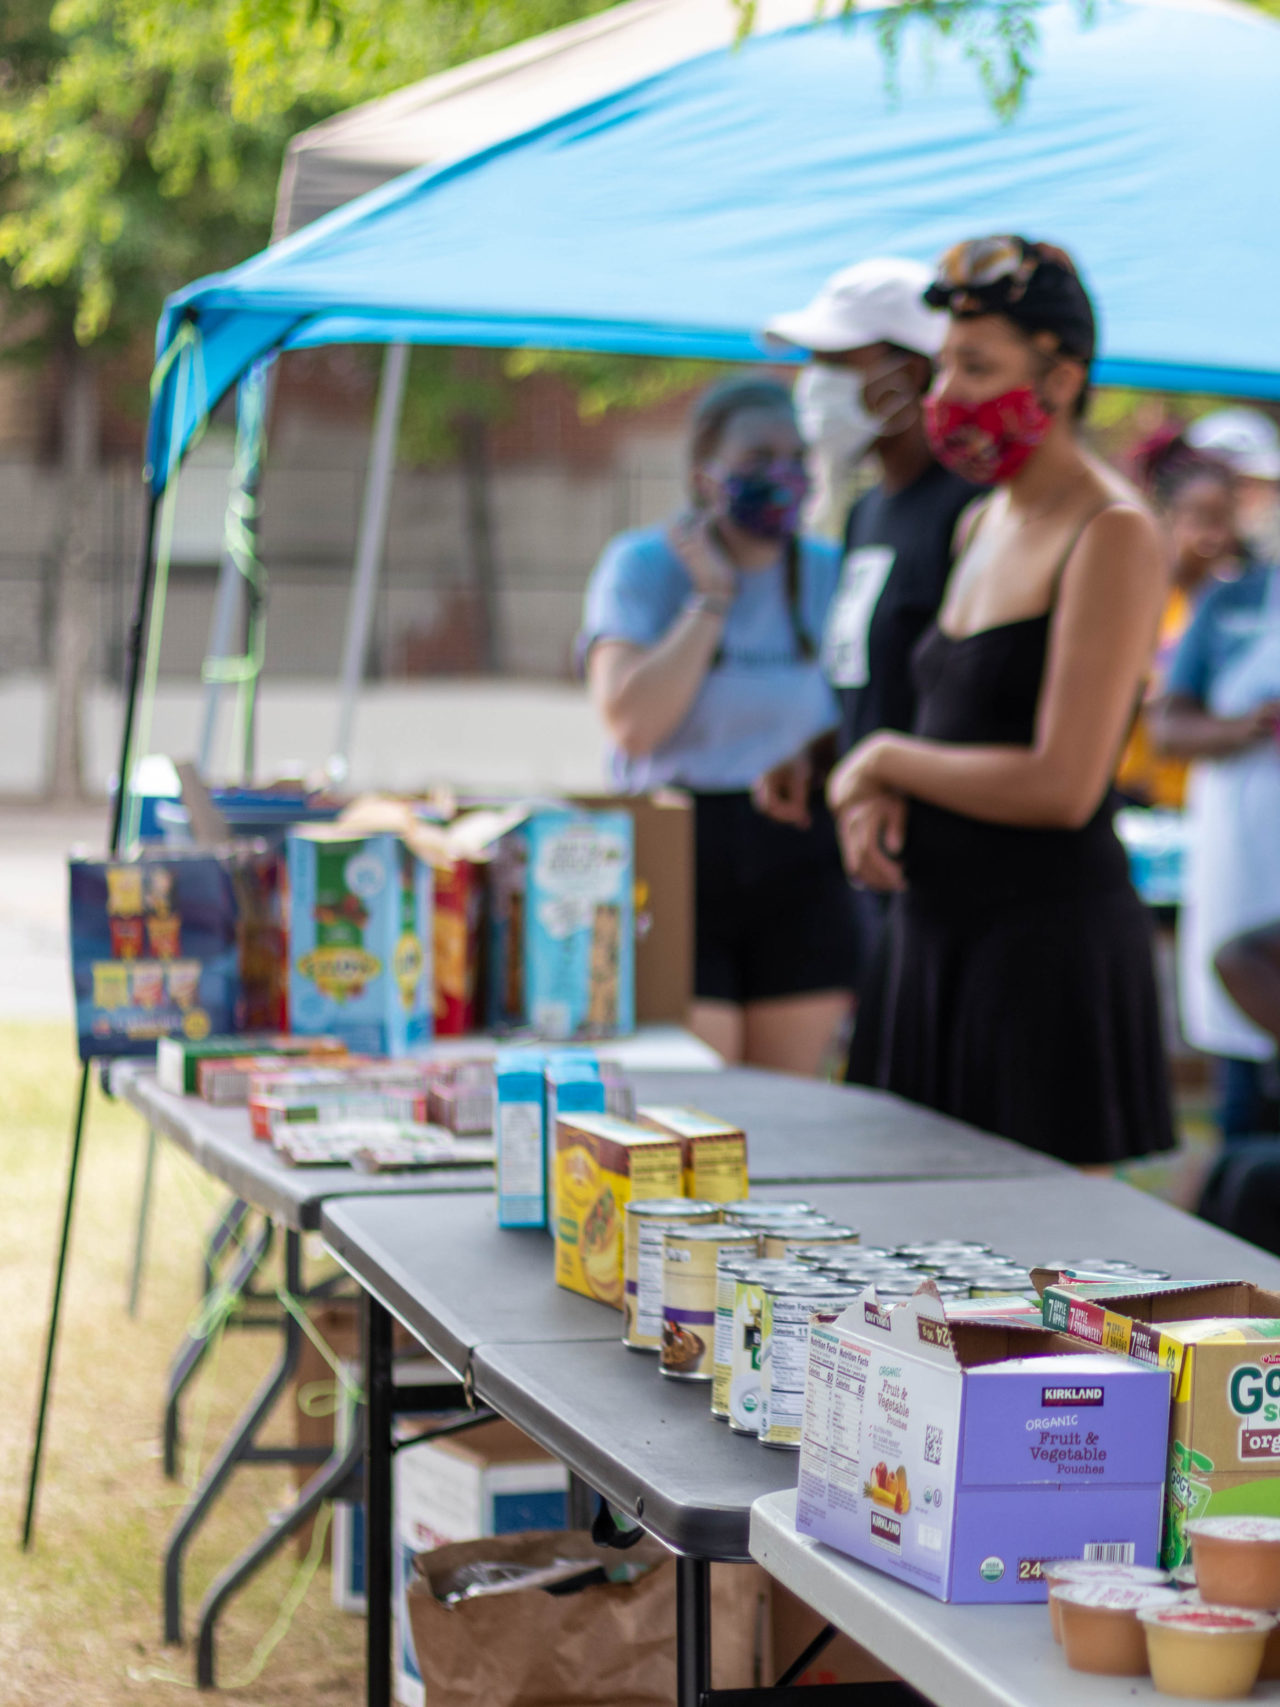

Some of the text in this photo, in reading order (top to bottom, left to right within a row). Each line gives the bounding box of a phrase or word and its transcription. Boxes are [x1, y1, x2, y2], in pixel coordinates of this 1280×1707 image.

[1048, 1299, 1067, 1323] 7 APPLE
[1052, 1312, 1066, 1328] APPLE
[1070, 1307, 1089, 1331] 7 APPLE
[1073, 1321, 1103, 1344] STRAWBERRY
[1105, 1321, 1125, 1346] 7 APPLE
[1130, 1331, 1152, 1355] 7 APPLE
[840, 1348, 869, 1367] Nutrition Facts
[882, 1379, 901, 1398] Fruit
[1045, 1388, 1102, 1400] KIRKLAND
[877, 1392, 910, 1419] Vegetable
[1025, 1414, 1079, 1432] ORGANIC
[1039, 1431, 1100, 1446] Fruit &
[1028, 1446, 1108, 1464] Vegetable
[1056, 1463, 1105, 1475] Pouches
[871, 1511, 901, 1537] KIRKLAND
[1019, 1561, 1042, 1579] 24
